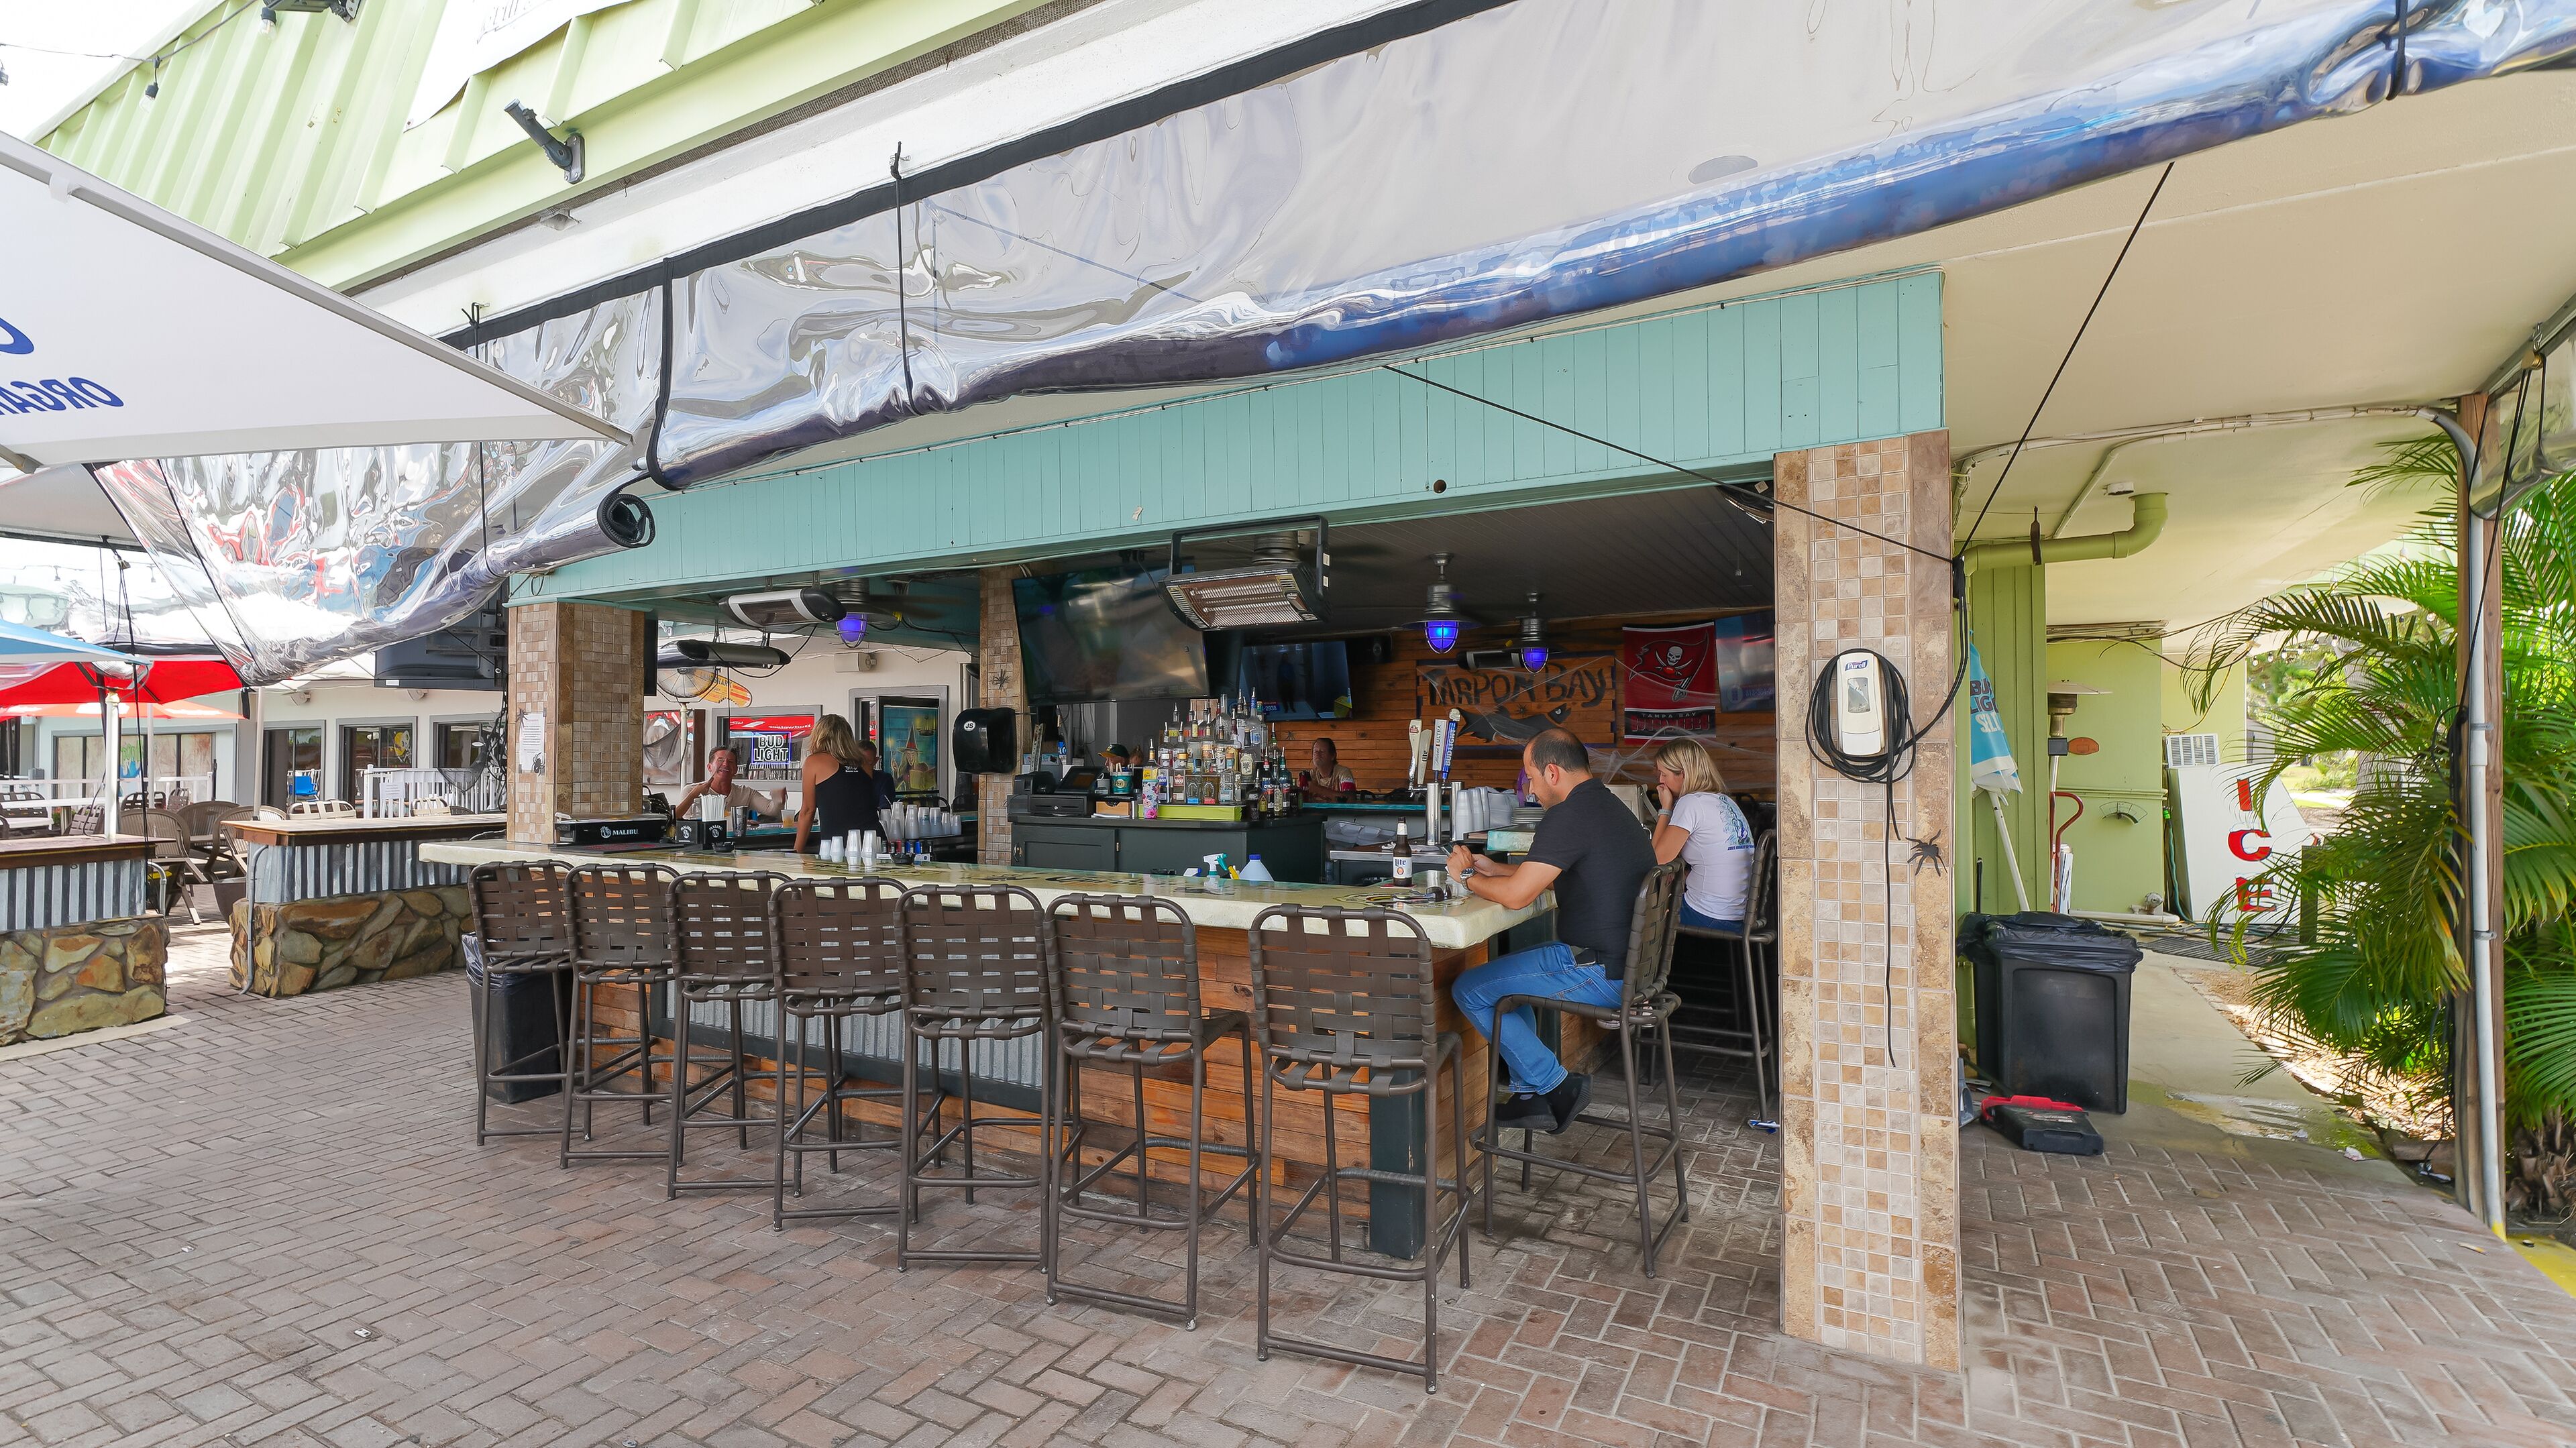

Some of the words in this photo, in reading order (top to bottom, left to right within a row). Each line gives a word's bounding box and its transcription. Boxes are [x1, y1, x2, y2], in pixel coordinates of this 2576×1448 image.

[1422, 669, 1536, 706] TARPON
[1546, 663, 1606, 708] BAY
[758, 734, 784, 748] BUD
[753, 748, 788, 762] LIGHT
